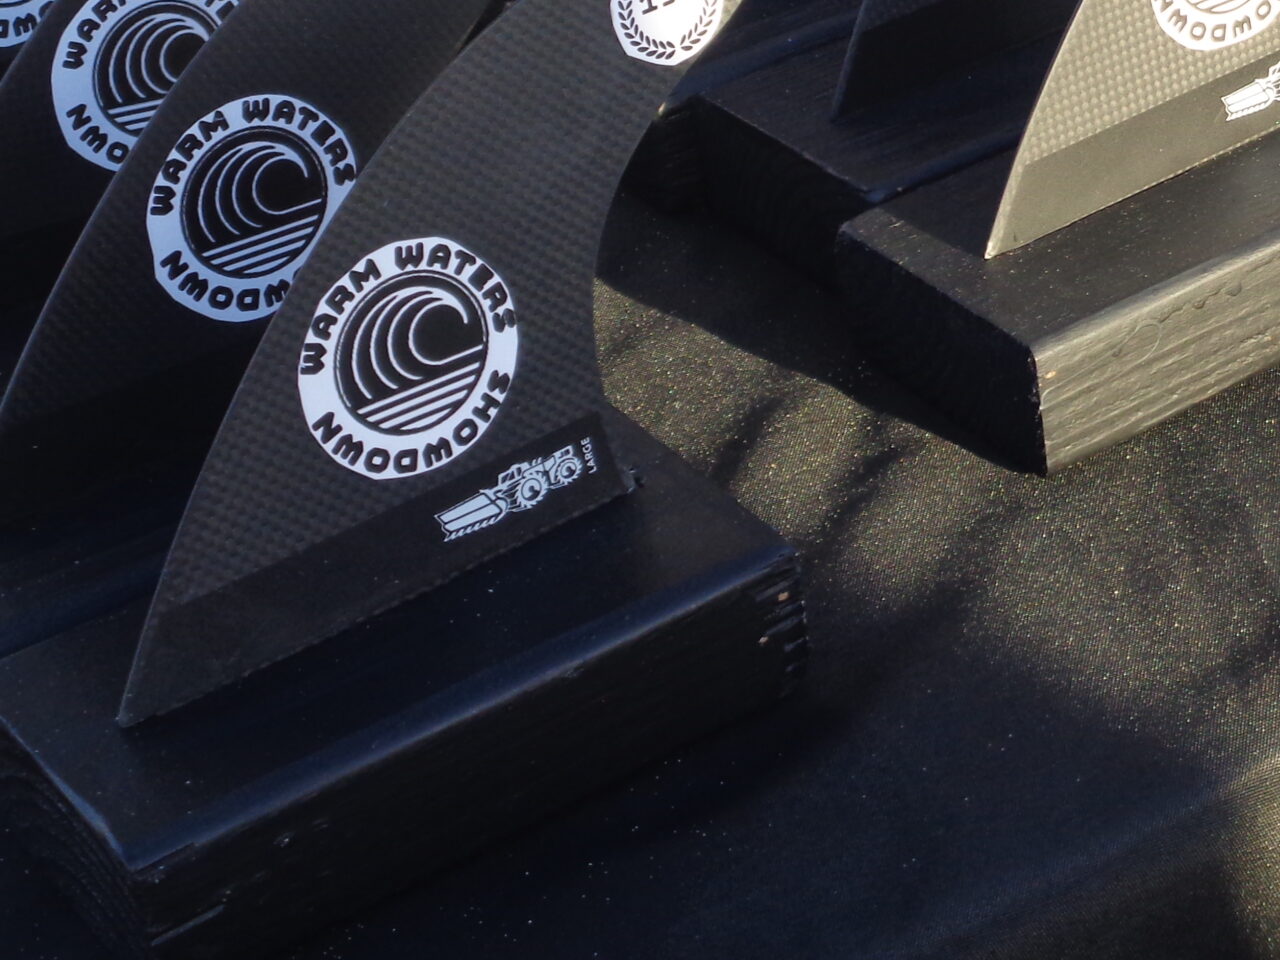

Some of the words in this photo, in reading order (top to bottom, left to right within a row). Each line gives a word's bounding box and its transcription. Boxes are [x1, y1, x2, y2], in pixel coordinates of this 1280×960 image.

[150, 110, 230, 216] WARM
[242, 97, 357, 186] WATERS
[300, 258, 382, 375] WARM
[394, 242, 517, 334] WATERS
[311, 369, 511, 475] SHOWDOWN
[580, 436, 598, 475] LARGE
